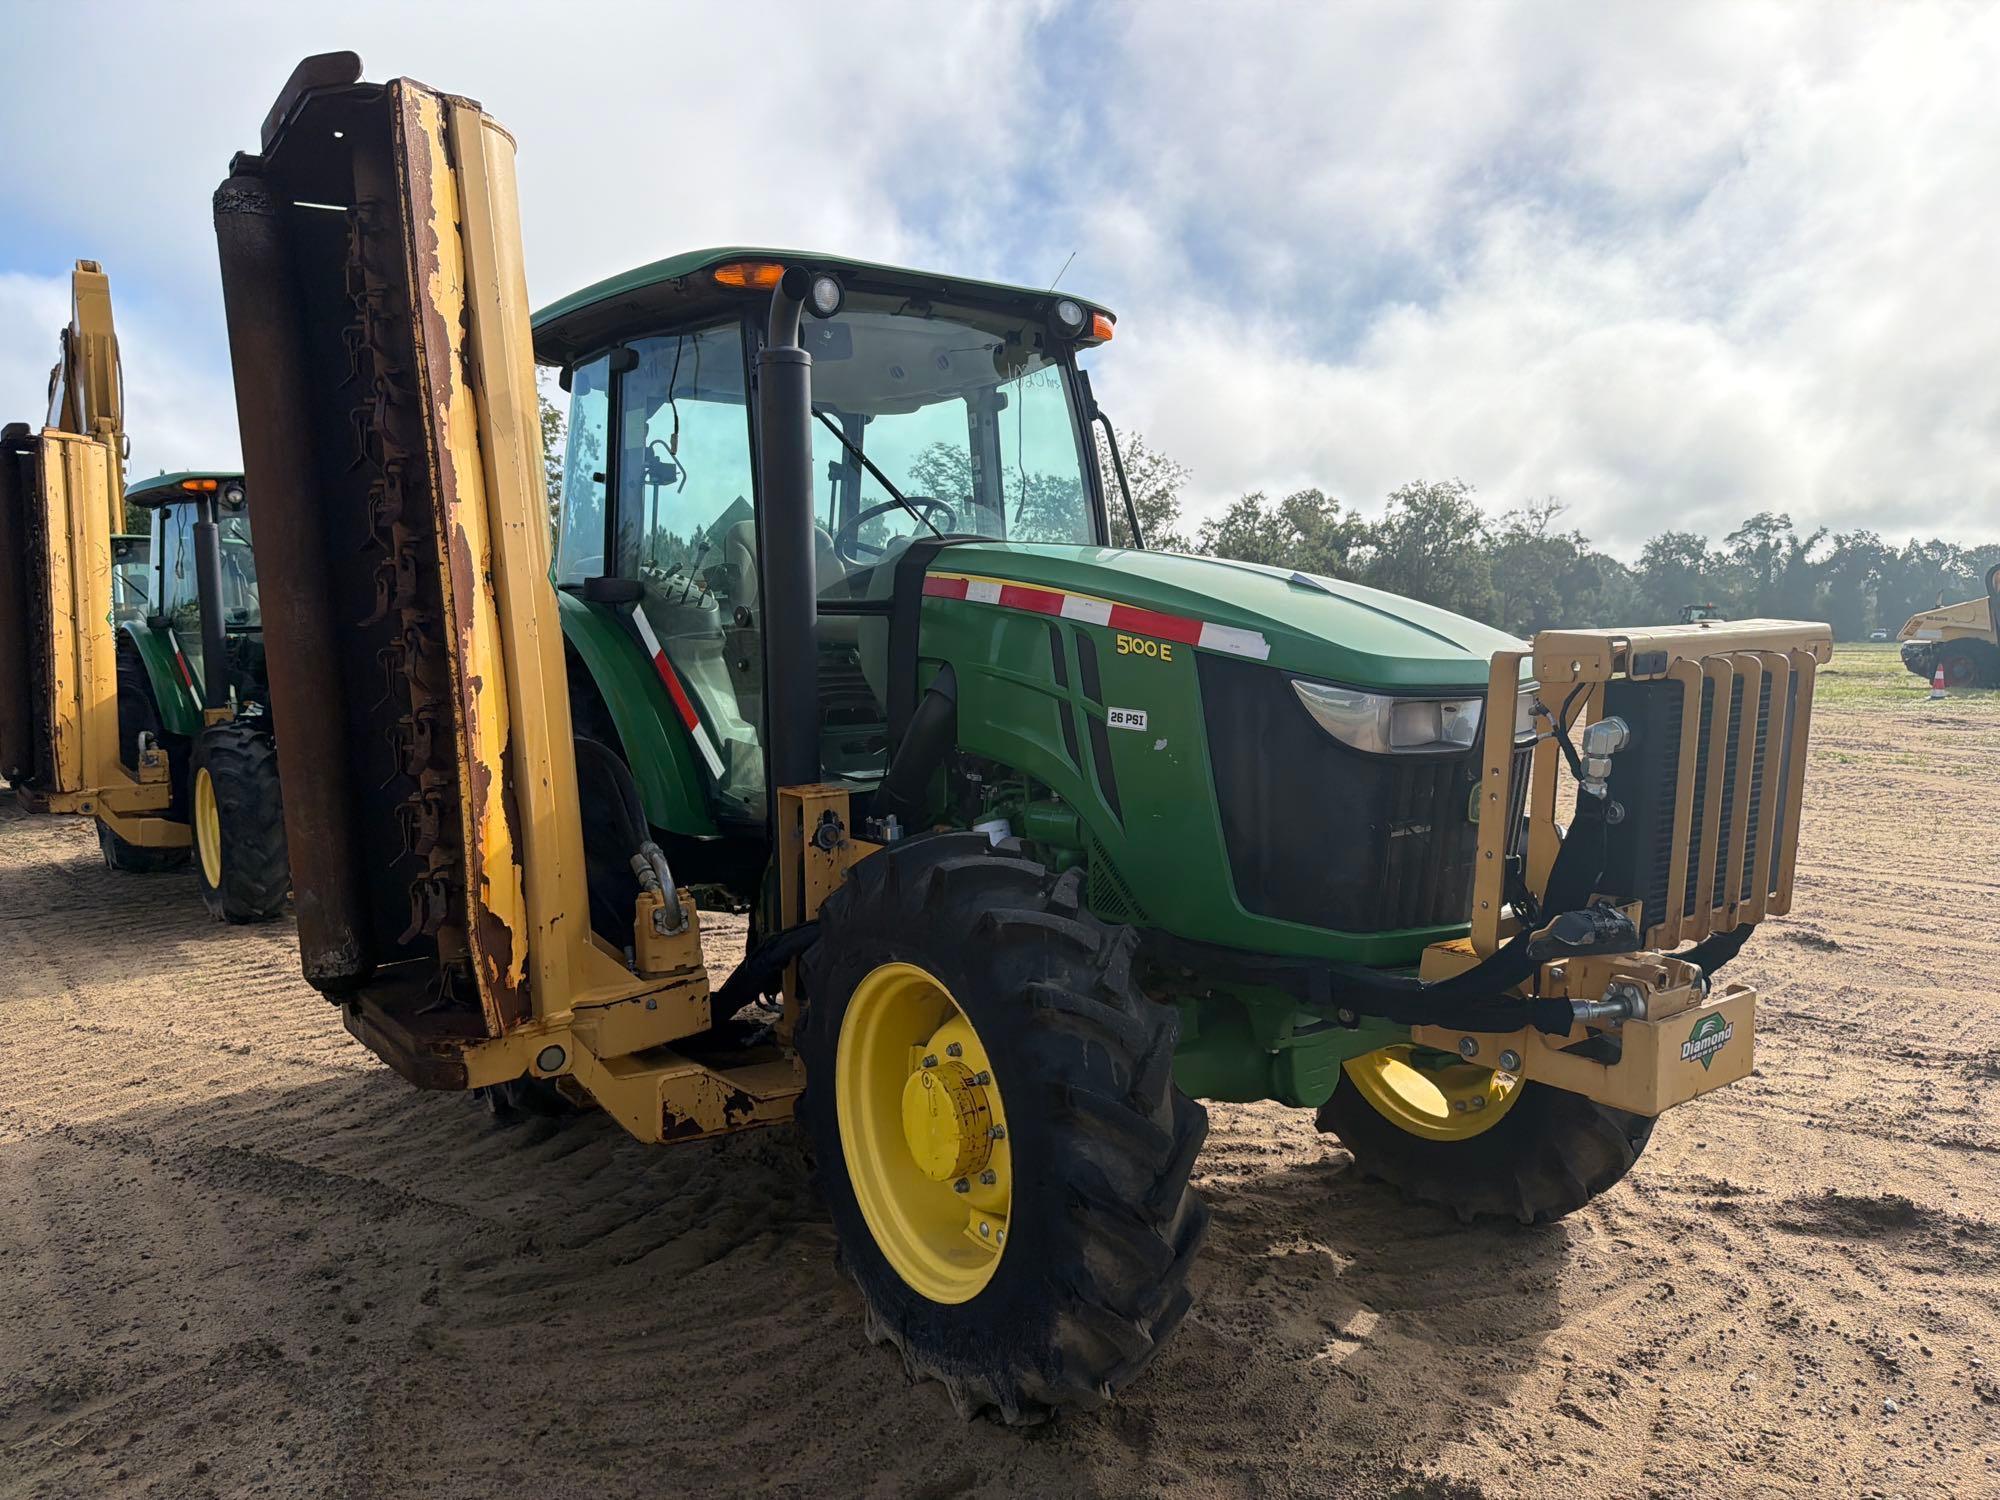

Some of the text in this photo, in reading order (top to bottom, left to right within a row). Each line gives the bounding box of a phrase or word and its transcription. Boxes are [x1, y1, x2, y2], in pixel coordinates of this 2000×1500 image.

[1116, 634, 1172, 661] 5100 E
[1110, 711, 1144, 726] 26 PSI
[1681, 1022, 1733, 1058] Diamond
